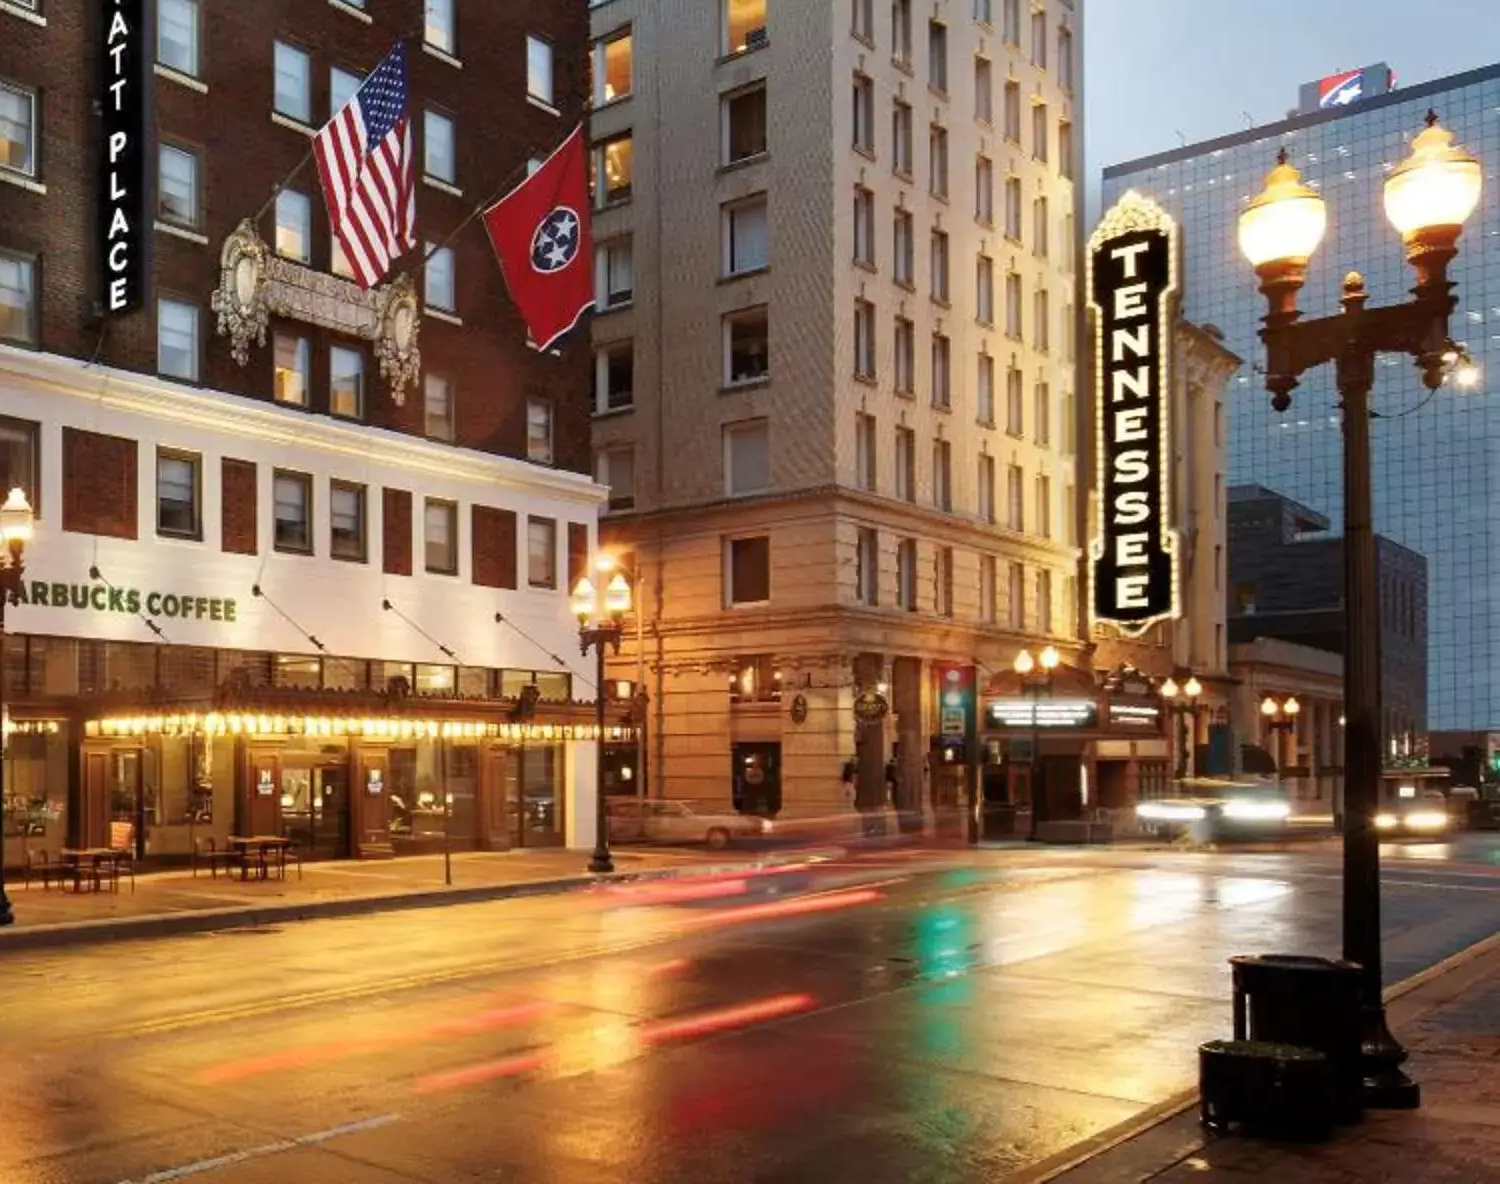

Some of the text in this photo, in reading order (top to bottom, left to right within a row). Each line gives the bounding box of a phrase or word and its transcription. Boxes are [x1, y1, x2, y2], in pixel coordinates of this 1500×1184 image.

[107, 130, 130, 311] PLACE
[1111, 240, 1151, 610] TENNESSEE
[145, 592, 238, 622] COFFEE
